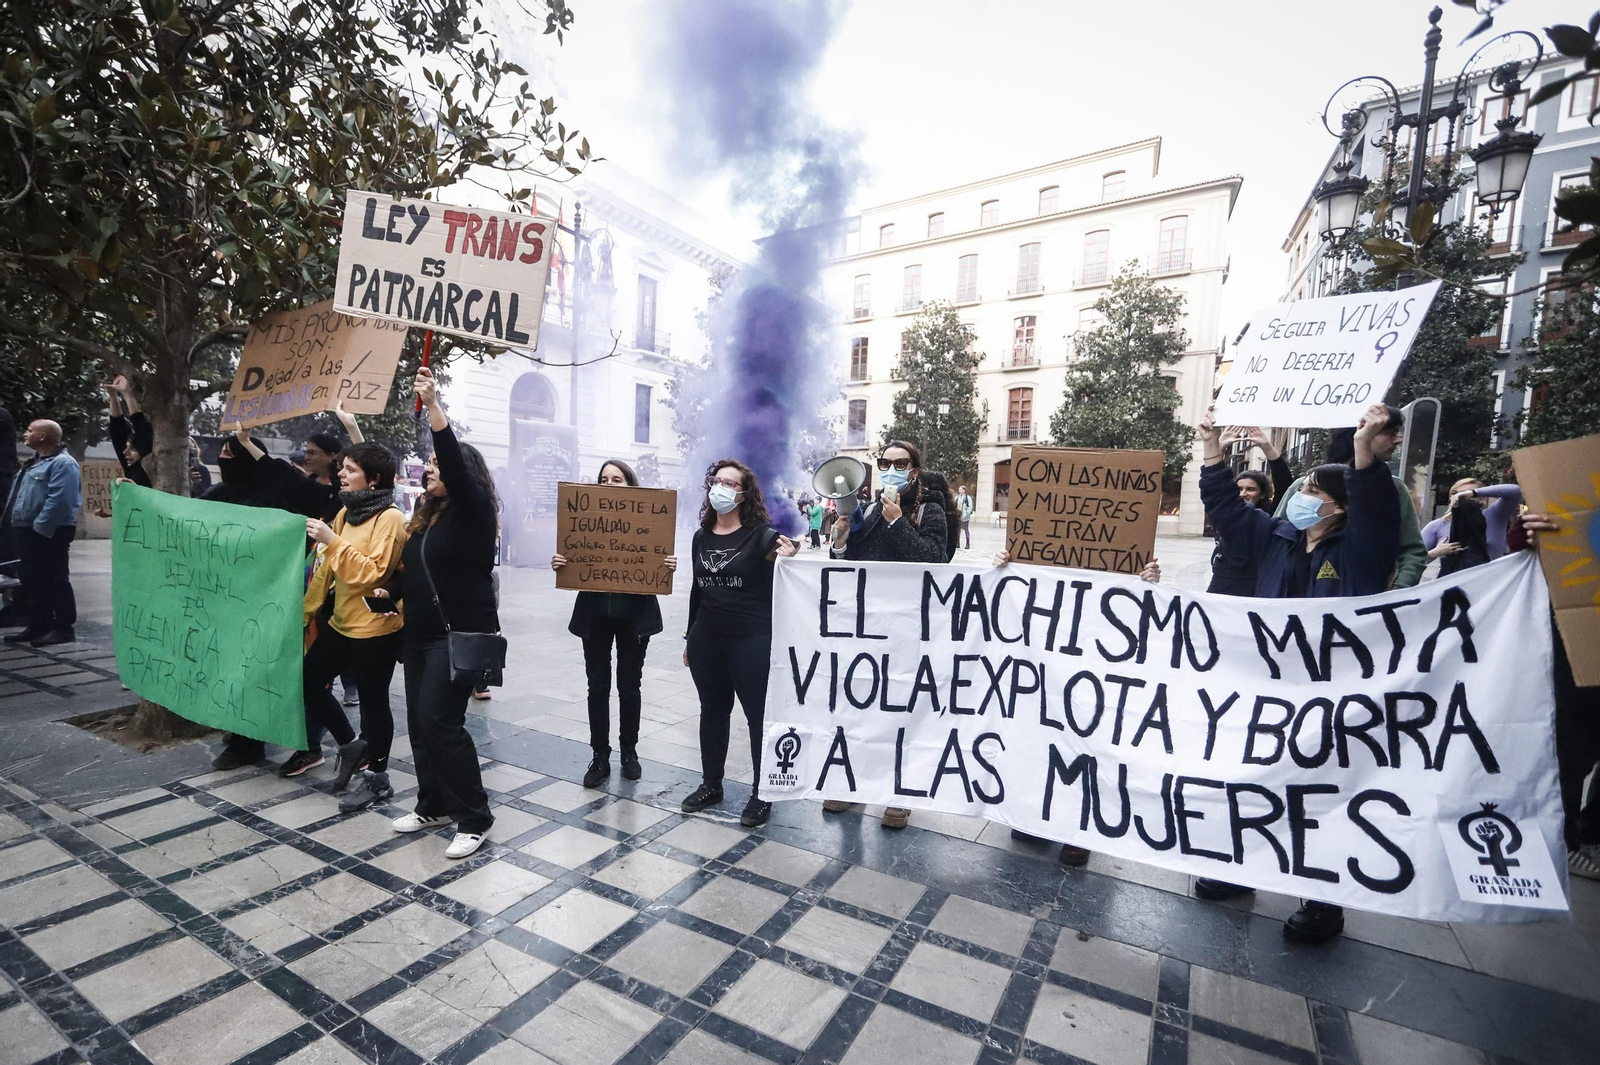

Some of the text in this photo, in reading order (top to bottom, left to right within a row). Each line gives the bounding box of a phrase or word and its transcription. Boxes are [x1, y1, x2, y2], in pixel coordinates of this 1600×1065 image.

[362, 198, 547, 264] LEY TRANS
[421, 257, 446, 278] ES
[347, 264, 529, 344] PATRIARCAL
[250, 319, 300, 345] MIS
[1260, 298, 1415, 341] SEGUIR VIVAS
[285, 335, 335, 361] SON:
[319, 355, 344, 376] las
[1245, 354, 1268, 374] NO
[311, 385, 329, 400] en
[336, 379, 381, 401] PAZ
[1229, 378, 1372, 406] SER UN LOGRO
[82, 465, 111, 480] FELIZ
[1015, 457, 1160, 493] CON LAS NIÑAS
[567, 490, 669, 515] NO EXISTE LA
[1015, 488, 1143, 522] Y MUJERES
[123, 508, 152, 549] EL
[569, 516, 651, 535] IGUALDAD DE
[1014, 517, 1117, 544] DE IRÁN
[623, 556, 645, 565] UNA
[654, 546, 669, 555] EL
[1009, 538, 1149, 574] Y AFGANISTÁN
[579, 563, 673, 588] JERARQUÍA
[819, 567, 1478, 682] EL MACHISMO MATA
[949, 654, 1174, 755] EXPLOTA
[1197, 688, 1240, 761] Y
[1242, 680, 1501, 774] BORRA
[815, 725, 1415, 894] A LAS MUJERES
[1469, 874, 1542, 889] GRANADA
[1477, 885, 1541, 899] RADFEM
